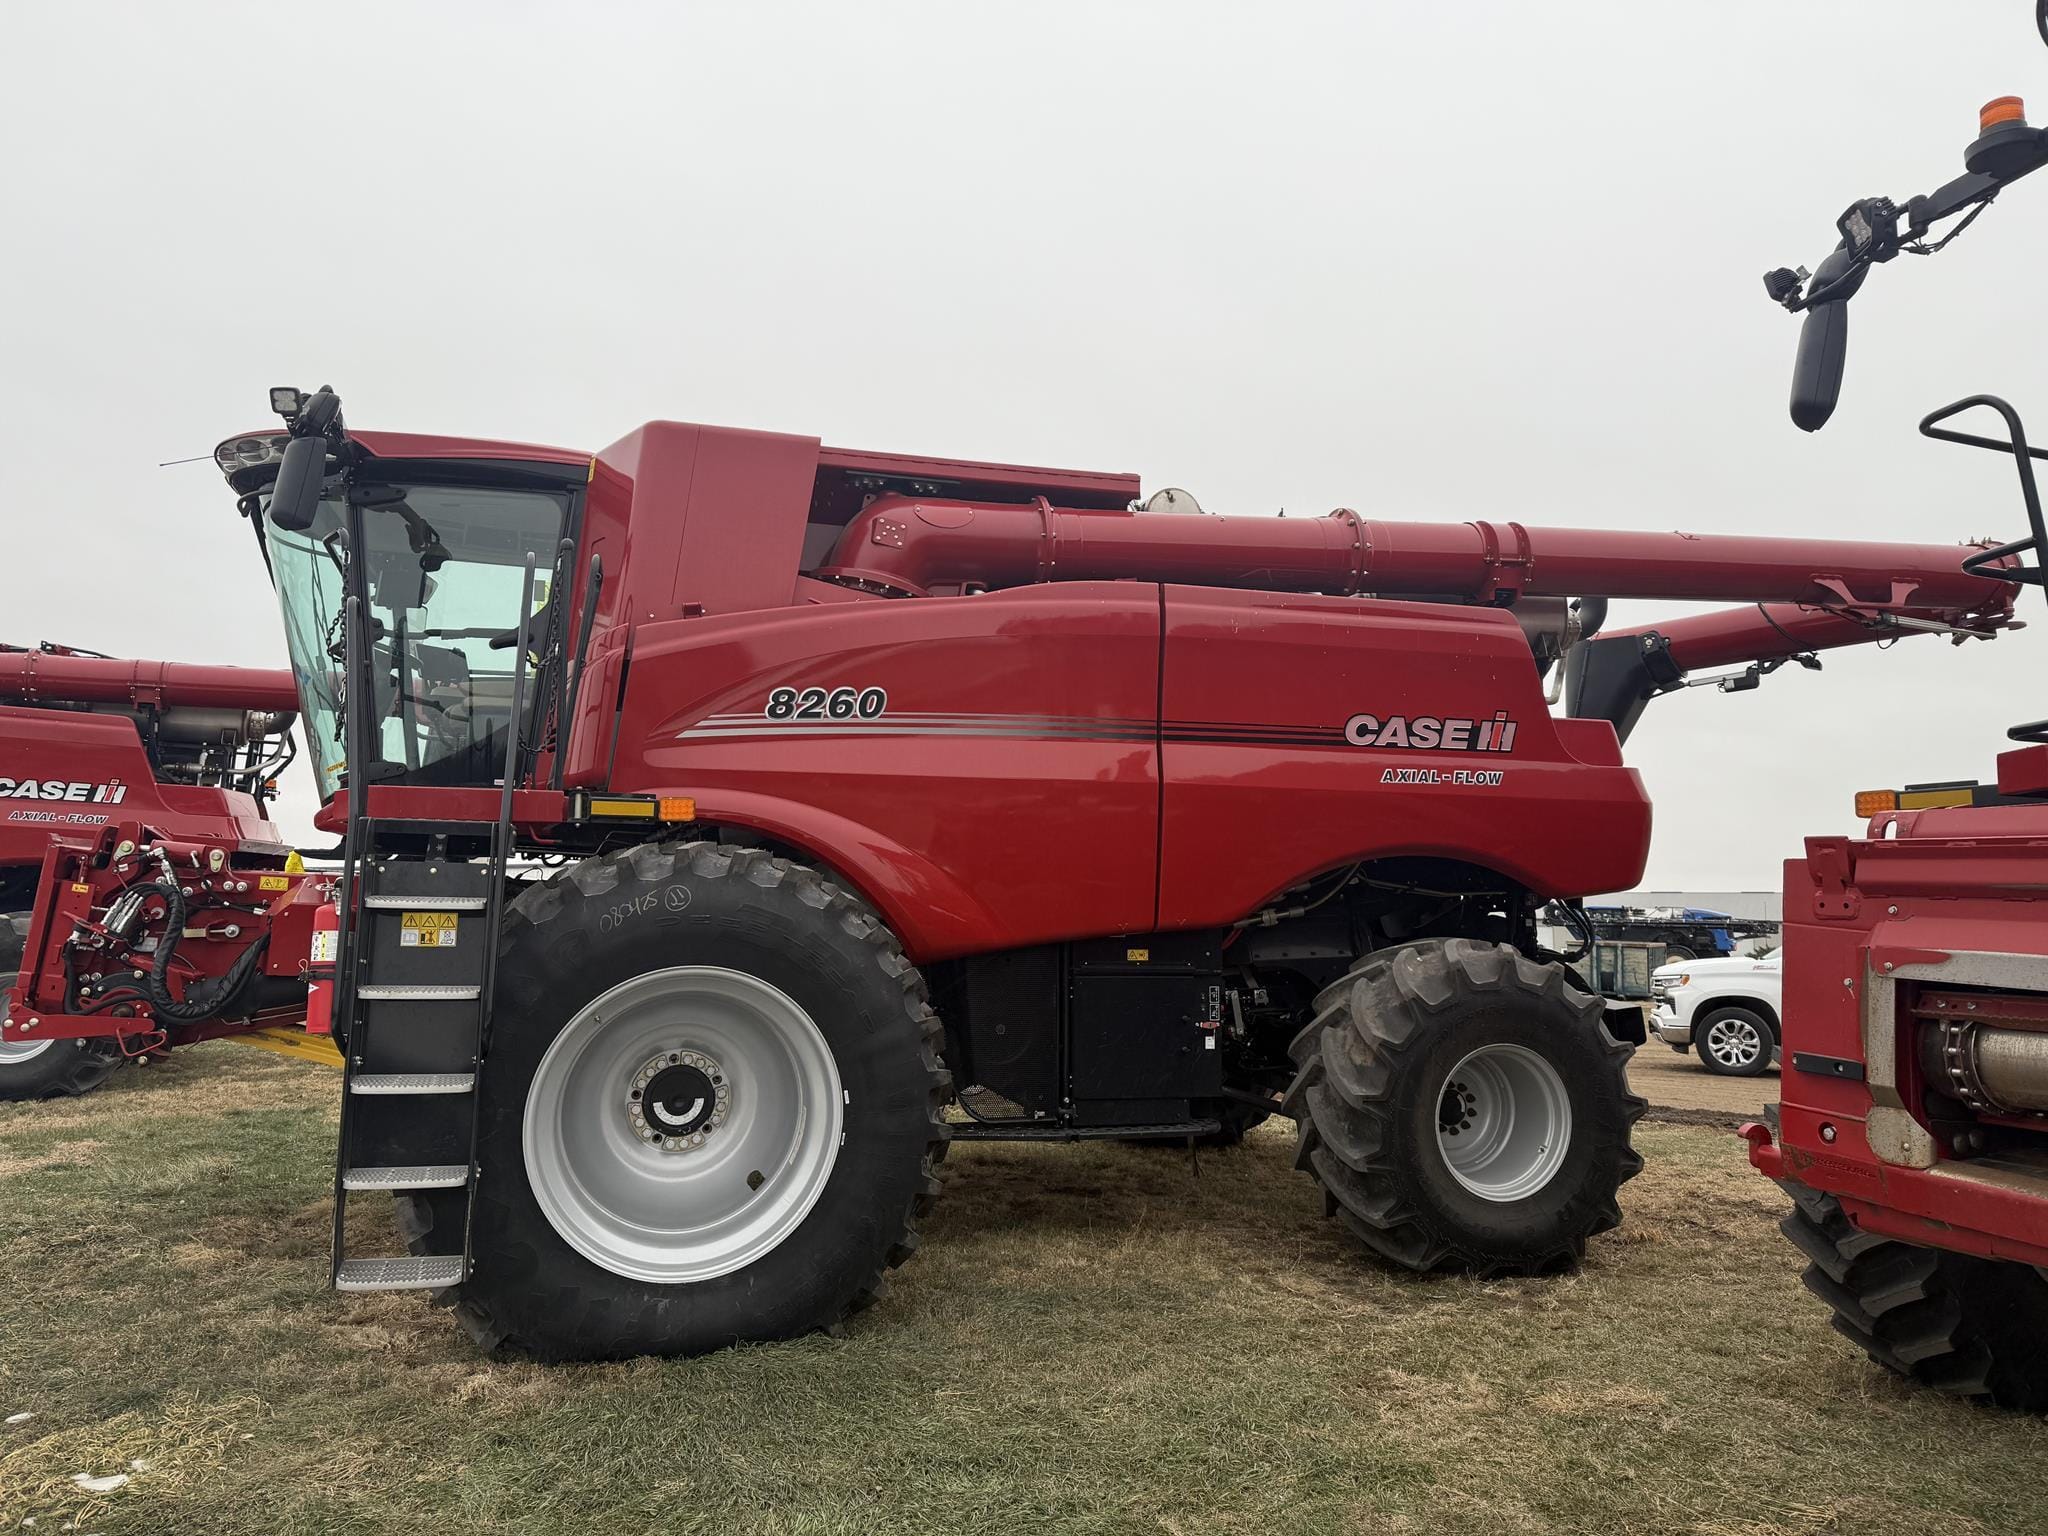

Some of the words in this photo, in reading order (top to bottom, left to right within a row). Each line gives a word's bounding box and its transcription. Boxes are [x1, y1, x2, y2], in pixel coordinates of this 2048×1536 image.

[765, 686, 887, 721] 8260
[1344, 713, 1474, 750] CASE
[0, 777, 92, 802] CASE
